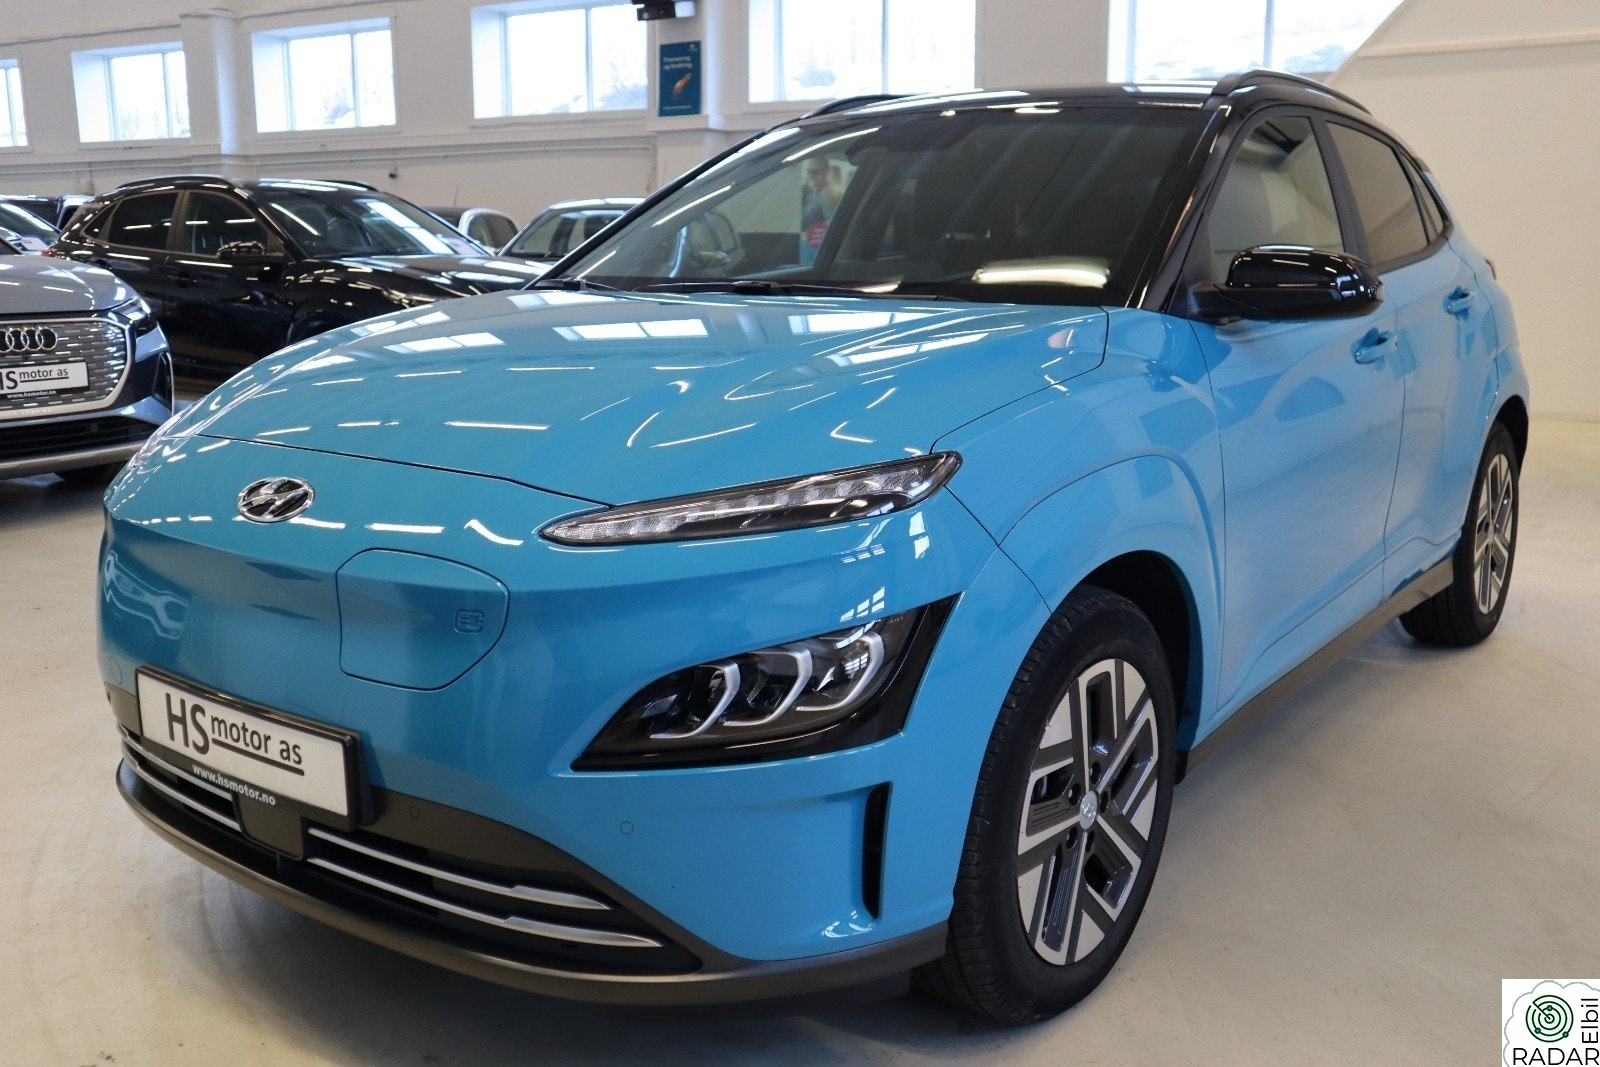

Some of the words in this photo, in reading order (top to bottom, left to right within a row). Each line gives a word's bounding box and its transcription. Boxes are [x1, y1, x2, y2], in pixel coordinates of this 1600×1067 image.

[19, 368, 53, 379] motor
[57, 367, 69, 376] as
[165, 692, 210, 756] HS
[210, 714, 272, 754] motor
[279, 739, 303, 765] as
[192, 763, 276, 806] www.hsmotor.no
